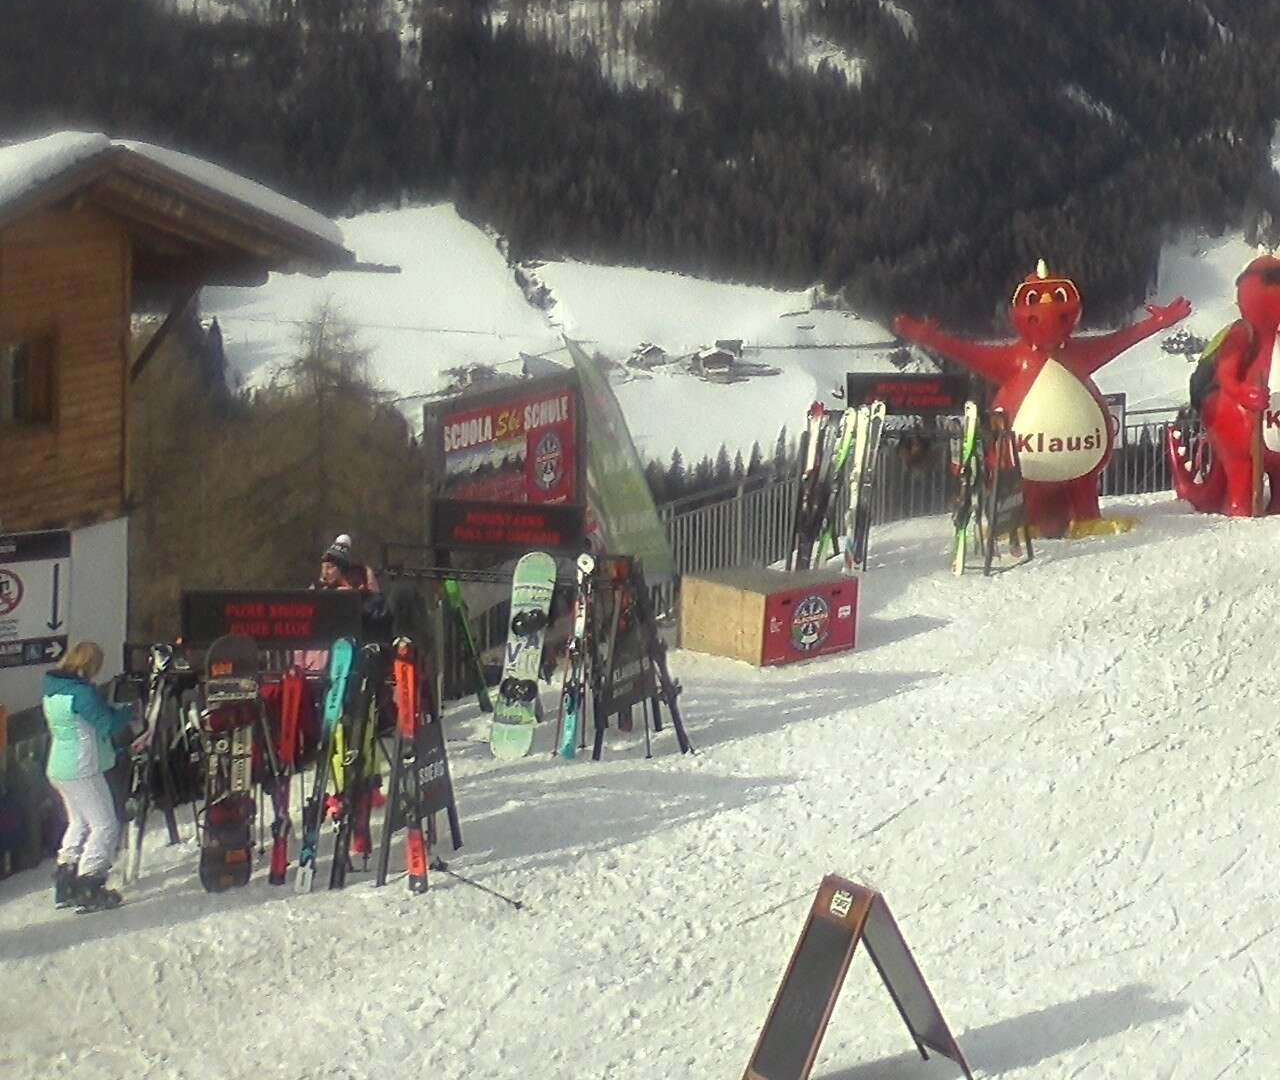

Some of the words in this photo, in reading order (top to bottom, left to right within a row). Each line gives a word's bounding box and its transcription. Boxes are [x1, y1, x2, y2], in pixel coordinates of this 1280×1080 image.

[444, 415, 492, 453] SCUOLA
[524, 395, 569, 431] SCHULE
[1018, 427, 1101, 453] Klausi
